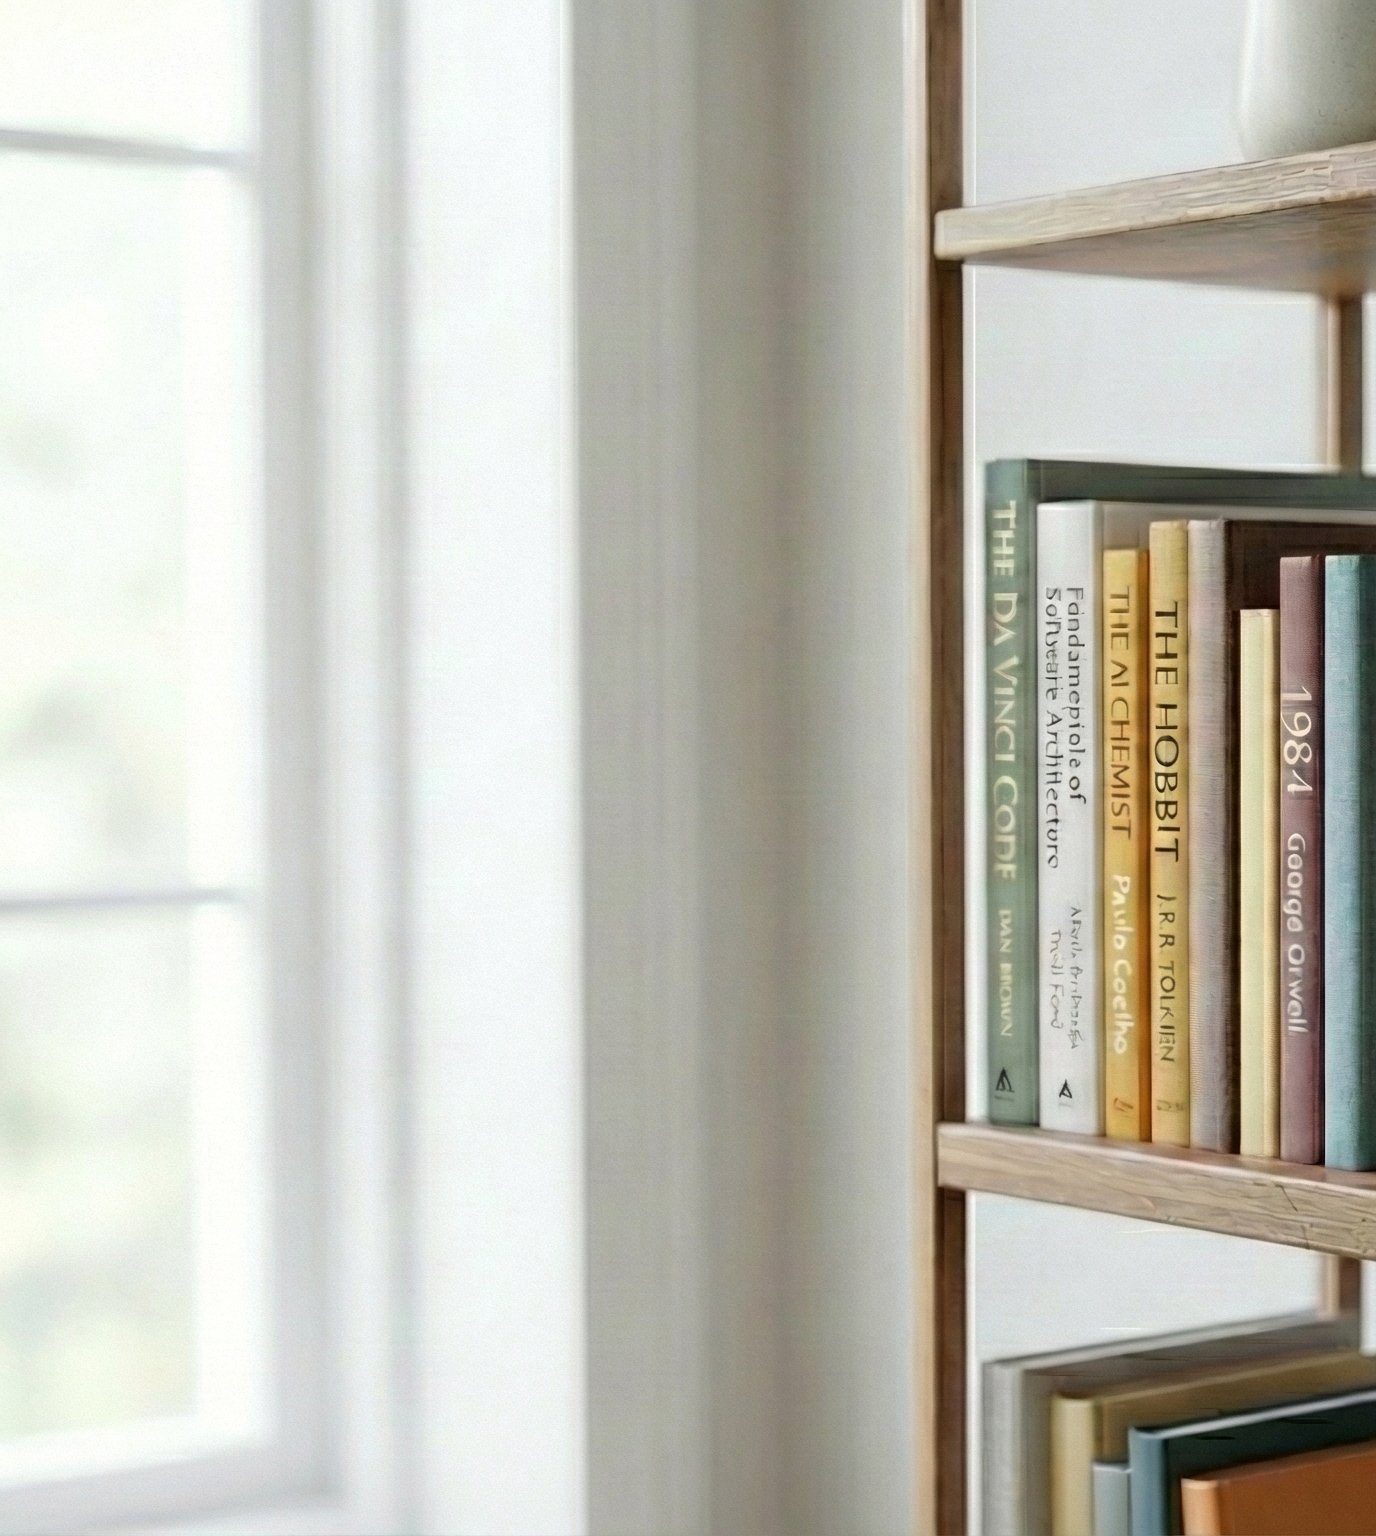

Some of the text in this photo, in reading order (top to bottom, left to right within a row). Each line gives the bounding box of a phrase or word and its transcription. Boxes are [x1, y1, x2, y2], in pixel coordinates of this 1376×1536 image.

[993, 500, 1017, 577] THE
[993, 593, 1018, 646] DA
[1109, 585, 1131, 651] THE
[993, 656, 1021, 762] VINCI
[1153, 600, 1181, 863] THE HOBBIT
[1068, 775, 1087, 805] of
[1110, 873, 1136, 1055] Paulo Coelho
